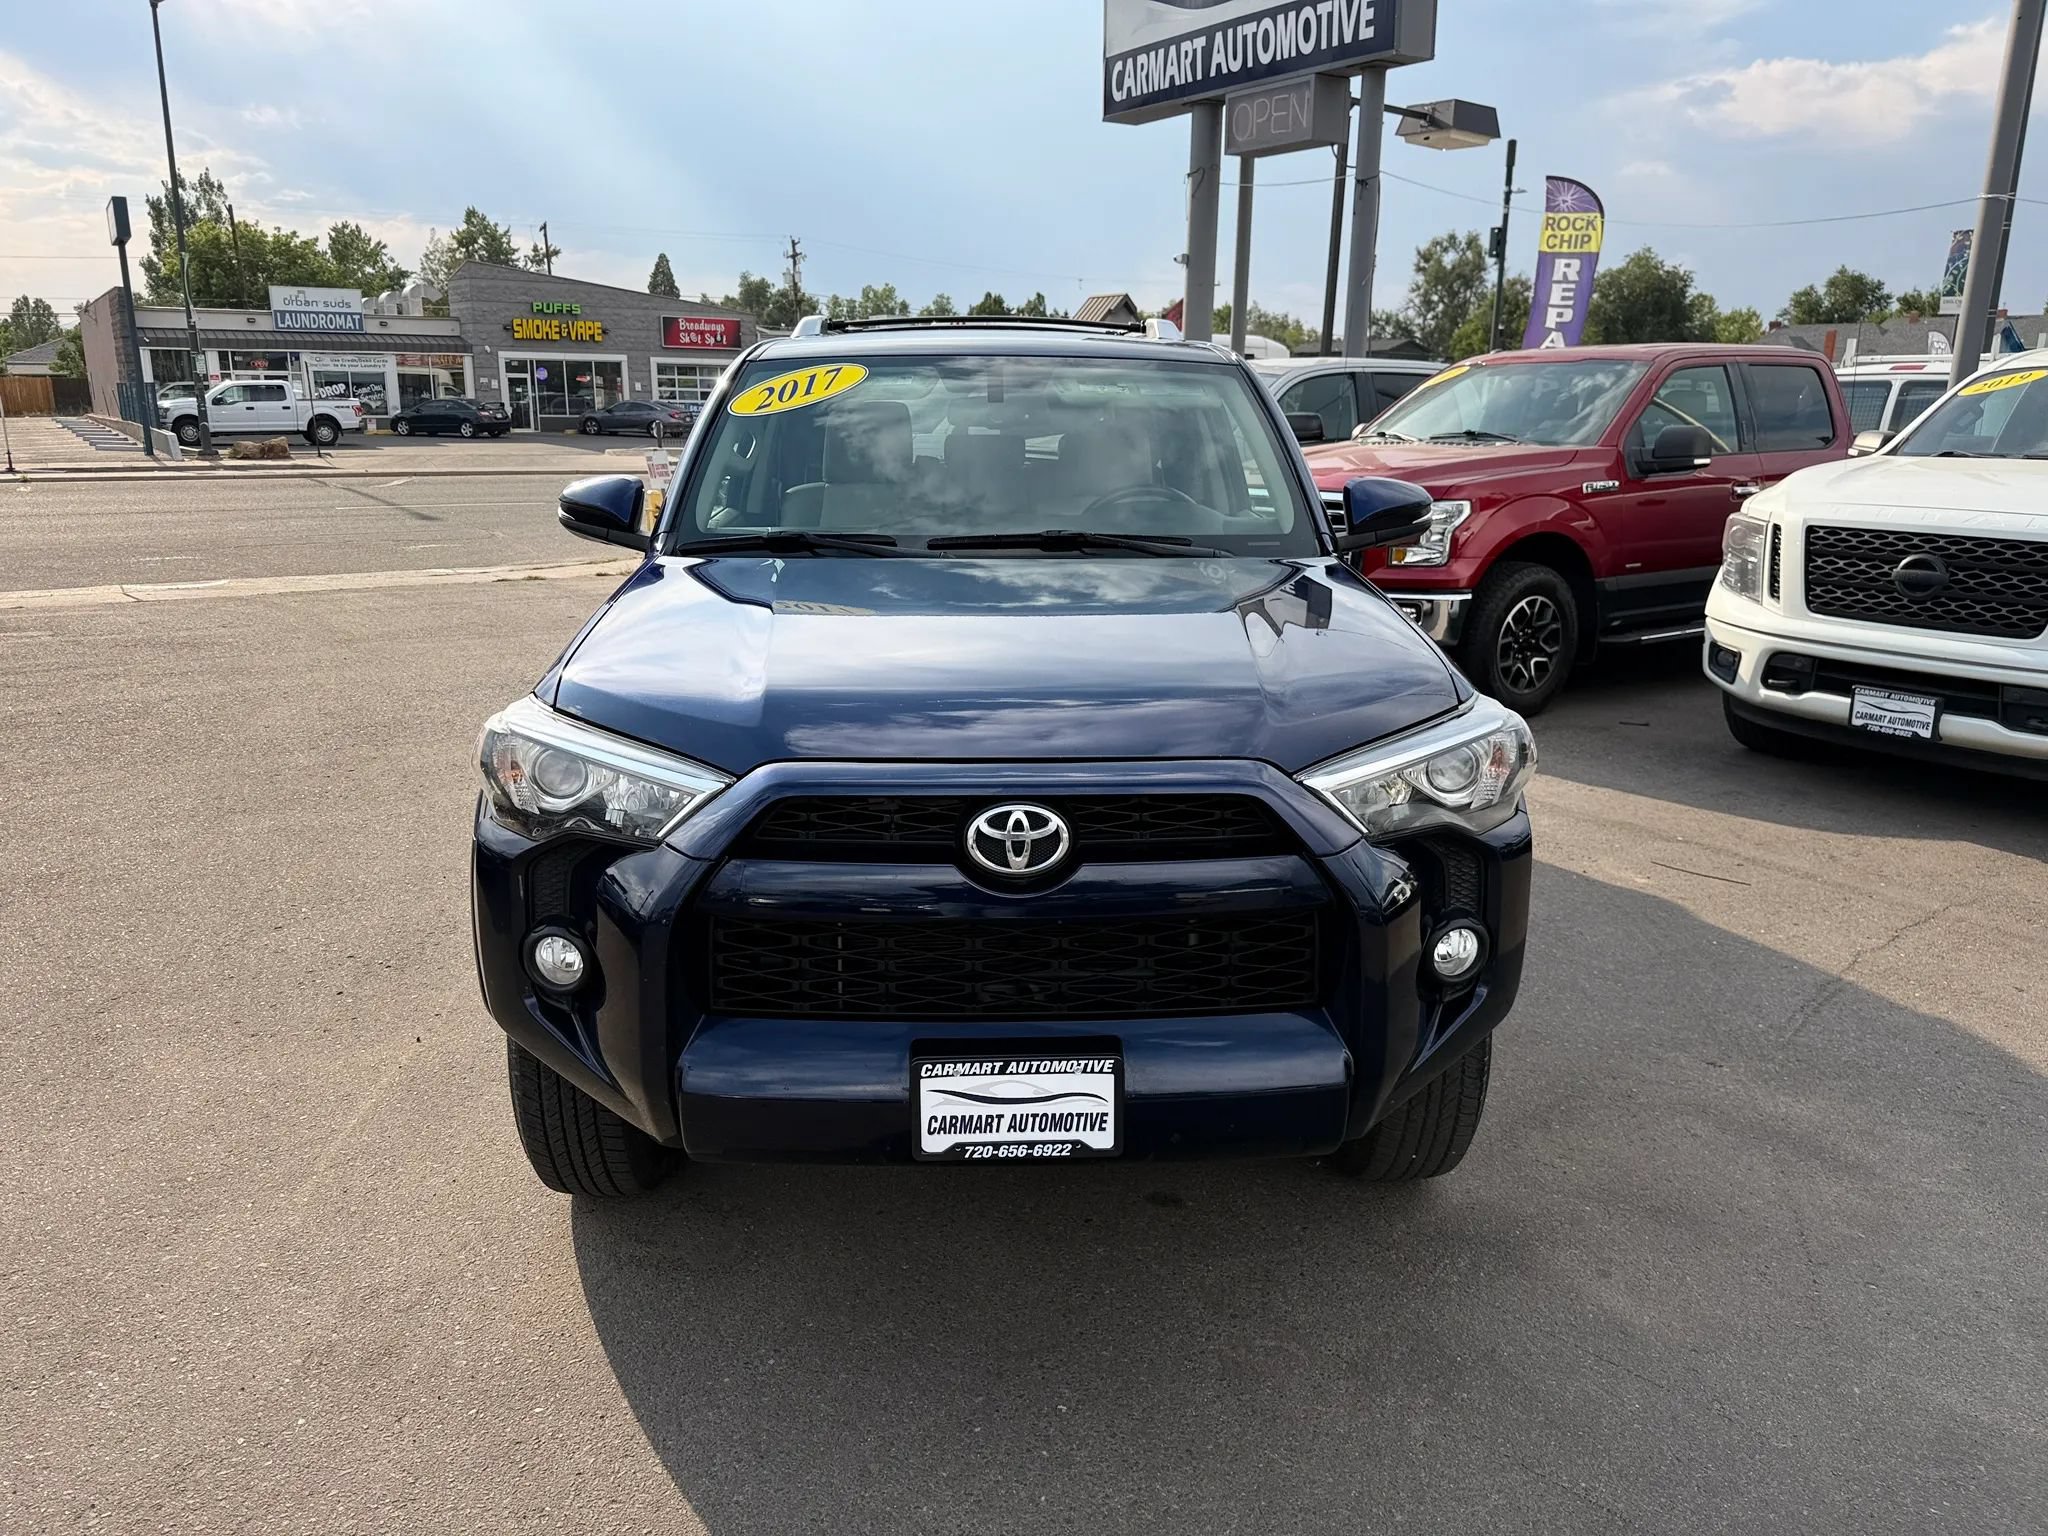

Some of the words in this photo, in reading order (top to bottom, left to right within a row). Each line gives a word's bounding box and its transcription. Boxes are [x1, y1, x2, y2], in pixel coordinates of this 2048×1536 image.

[1111, 35, 1206, 102] CARMART
[1209, 0, 1375, 77] AUTOMOTIVE
[1232, 90, 1311, 141] OPEN
[1544, 215, 1597, 232] ROCK
[1546, 233, 1592, 250] CHIP
[532, 302, 582, 315] PUFFS
[277, 312, 360, 330] LAUNDROMAT
[678, 318, 725, 332] Broadways
[250, 359, 269, 368] OPEN
[318, 383, 346, 398] DROP
[754, 366, 844, 412] 2017
[1974, 371, 2033, 392] 2019
[1854, 688, 1889, 699] CARMART
[1889, 693, 1936, 706] AUTOMOTIVE
[1854, 710, 1887, 724] CARMART
[1887, 716, 1931, 731] AUTOMOTIVE
[920, 1061, 1003, 1078] CARMART
[1006, 1059, 1114, 1075] AUTOMOTIVE
[927, 1114, 1004, 1136] CARMART
[1006, 1112, 1109, 1133] AUTOMOTIVE
[964, 1143, 1072, 1159] 720-656-6922
